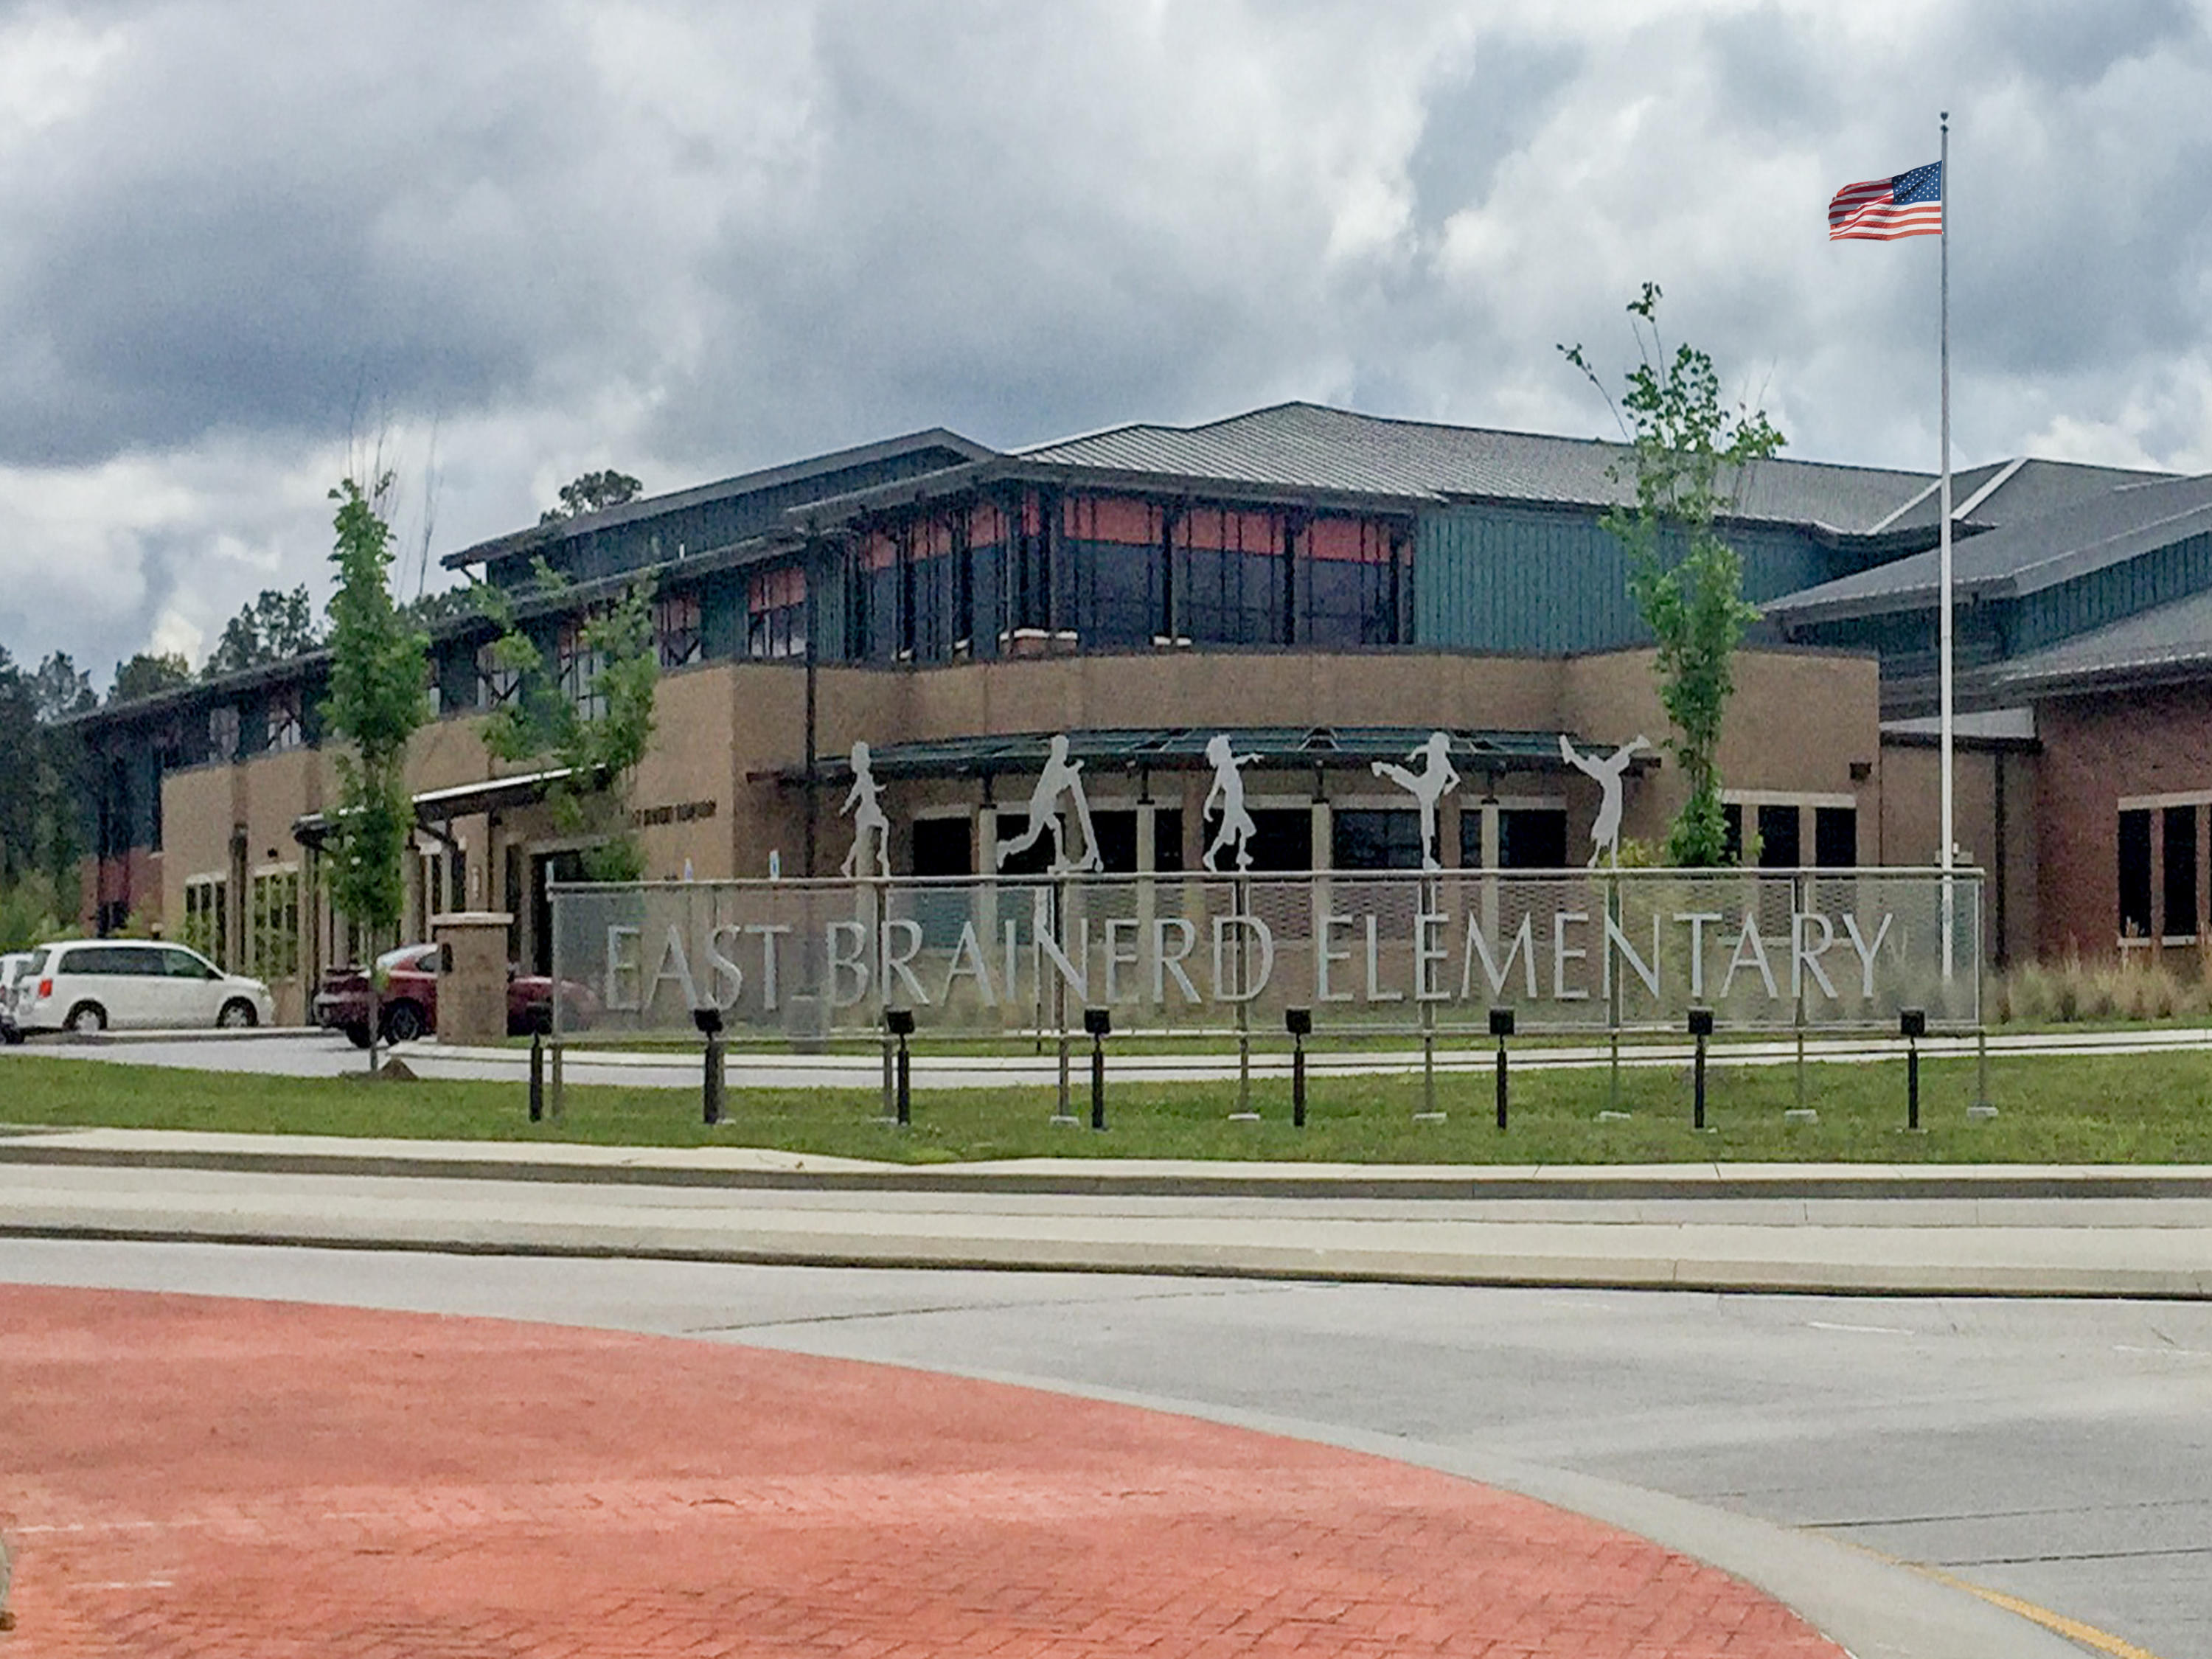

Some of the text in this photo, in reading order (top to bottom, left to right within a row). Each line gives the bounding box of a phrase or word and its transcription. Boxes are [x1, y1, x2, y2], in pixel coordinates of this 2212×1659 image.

[606, 911, 1893, 1011] EAST BRAINERD ELEMENTARY
